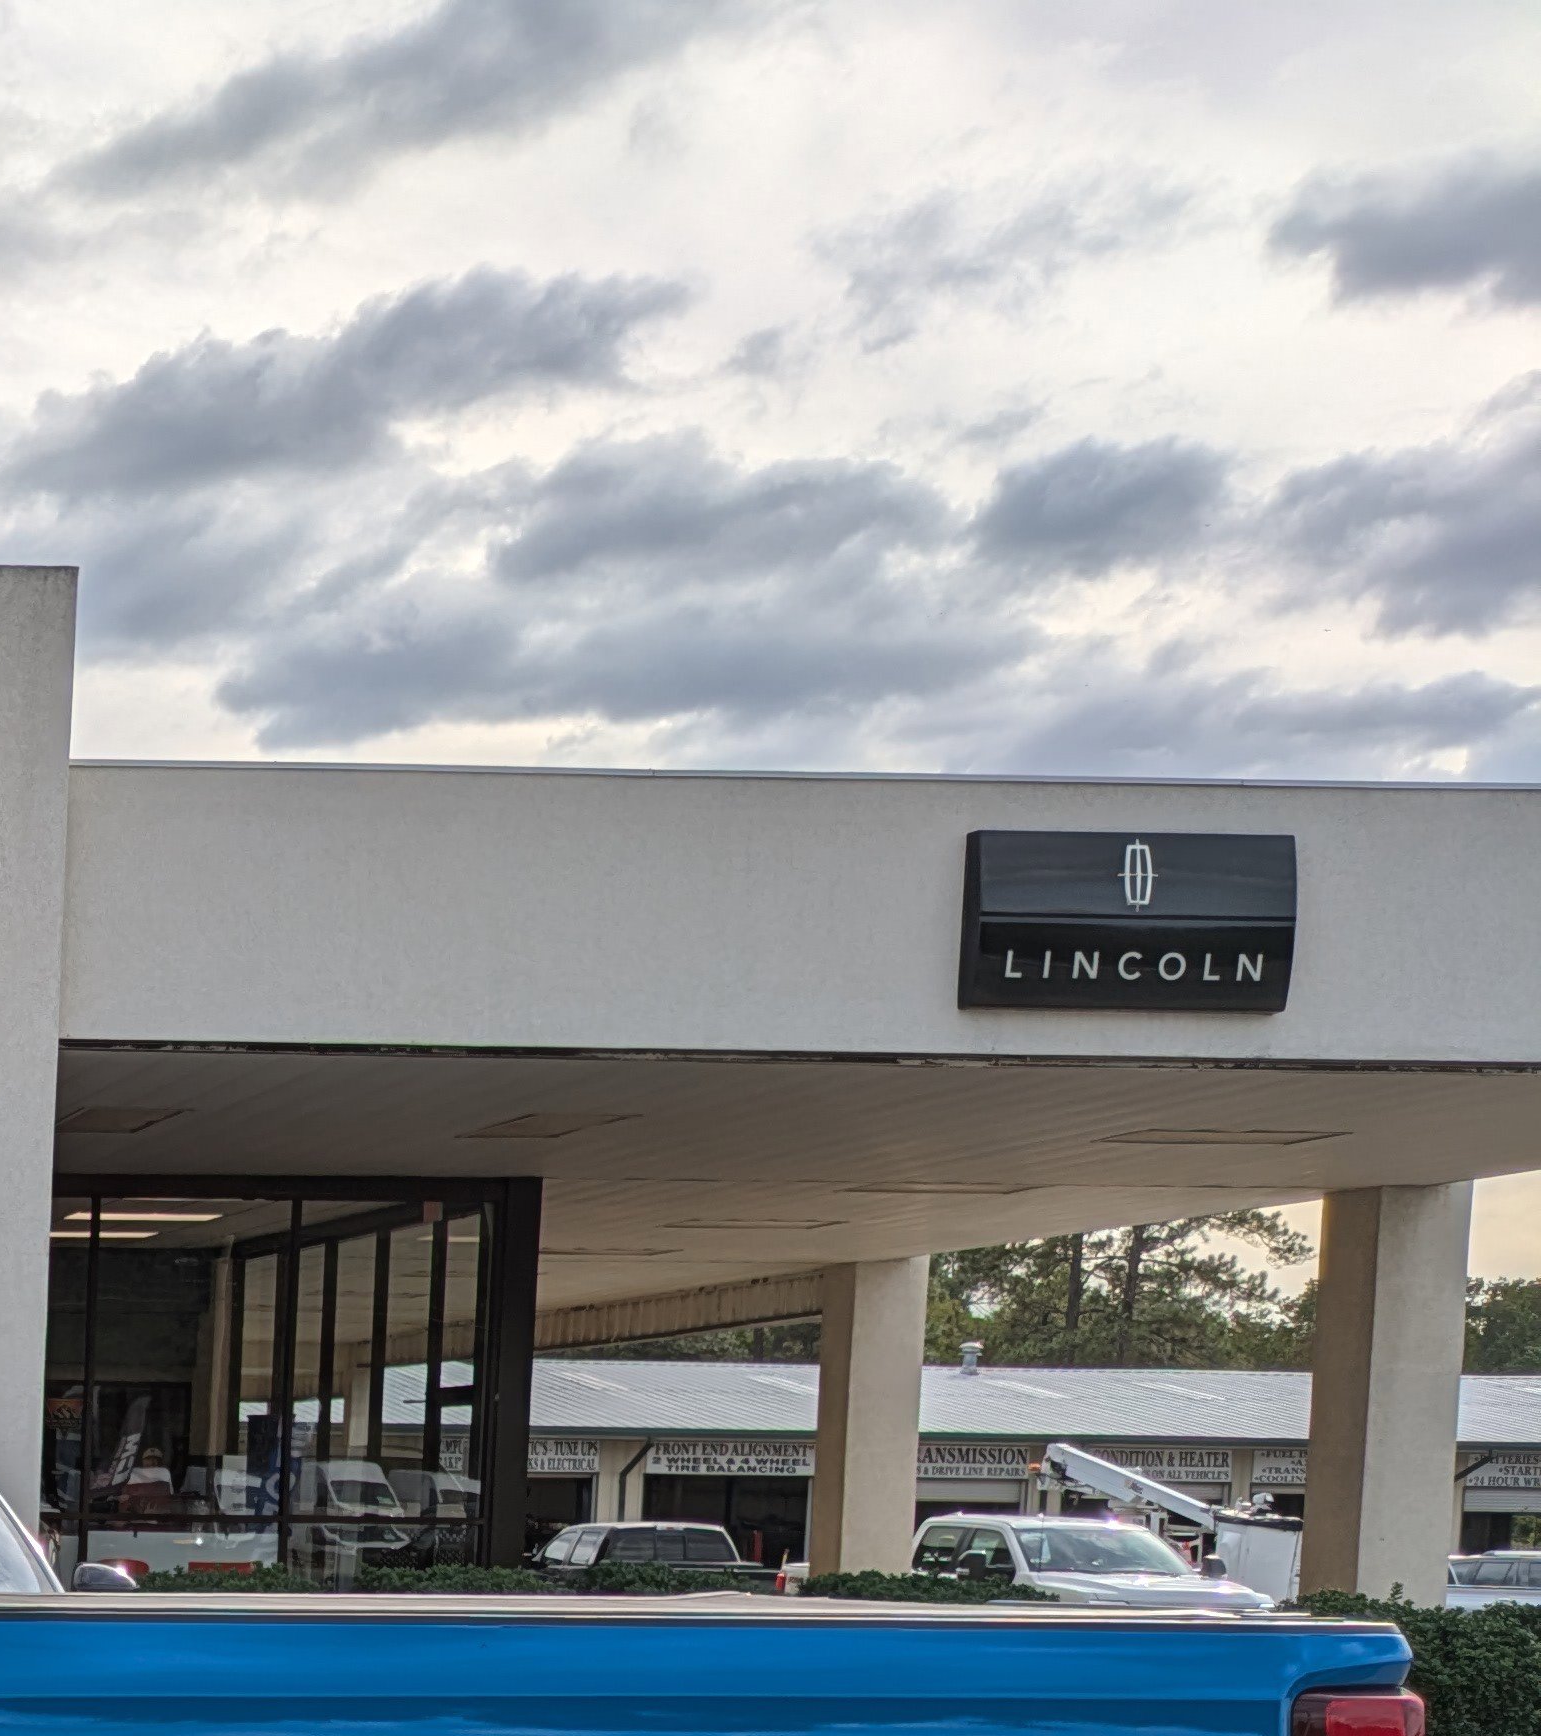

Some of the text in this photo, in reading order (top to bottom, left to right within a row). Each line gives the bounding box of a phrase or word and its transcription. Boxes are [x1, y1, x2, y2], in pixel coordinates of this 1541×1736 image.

[1004, 949, 1264, 982] LINCOLN
[554, 1440, 578, 1456] TUNE
[702, 1442, 729, 1456] END
[652, 1457, 662, 1465] 2
[666, 1457, 720, 1465] WHEEL
[755, 1458, 810, 1467] WHEEL
[1167, 1451, 1176, 1468] &
[1179, 1450, 1229, 1468] HEATER
[665, 1464, 797, 1474] TIRE BALANCING
[931, 1466, 961, 1475] DRIVE
[962, 1466, 985, 1476] LINE
[986, 1467, 1026, 1477] REPAIRS
[1167, 1469, 1183, 1480] ALL
[1503, 1466, 1541, 1476] START
[1488, 1476, 1520, 1487] HOUR
